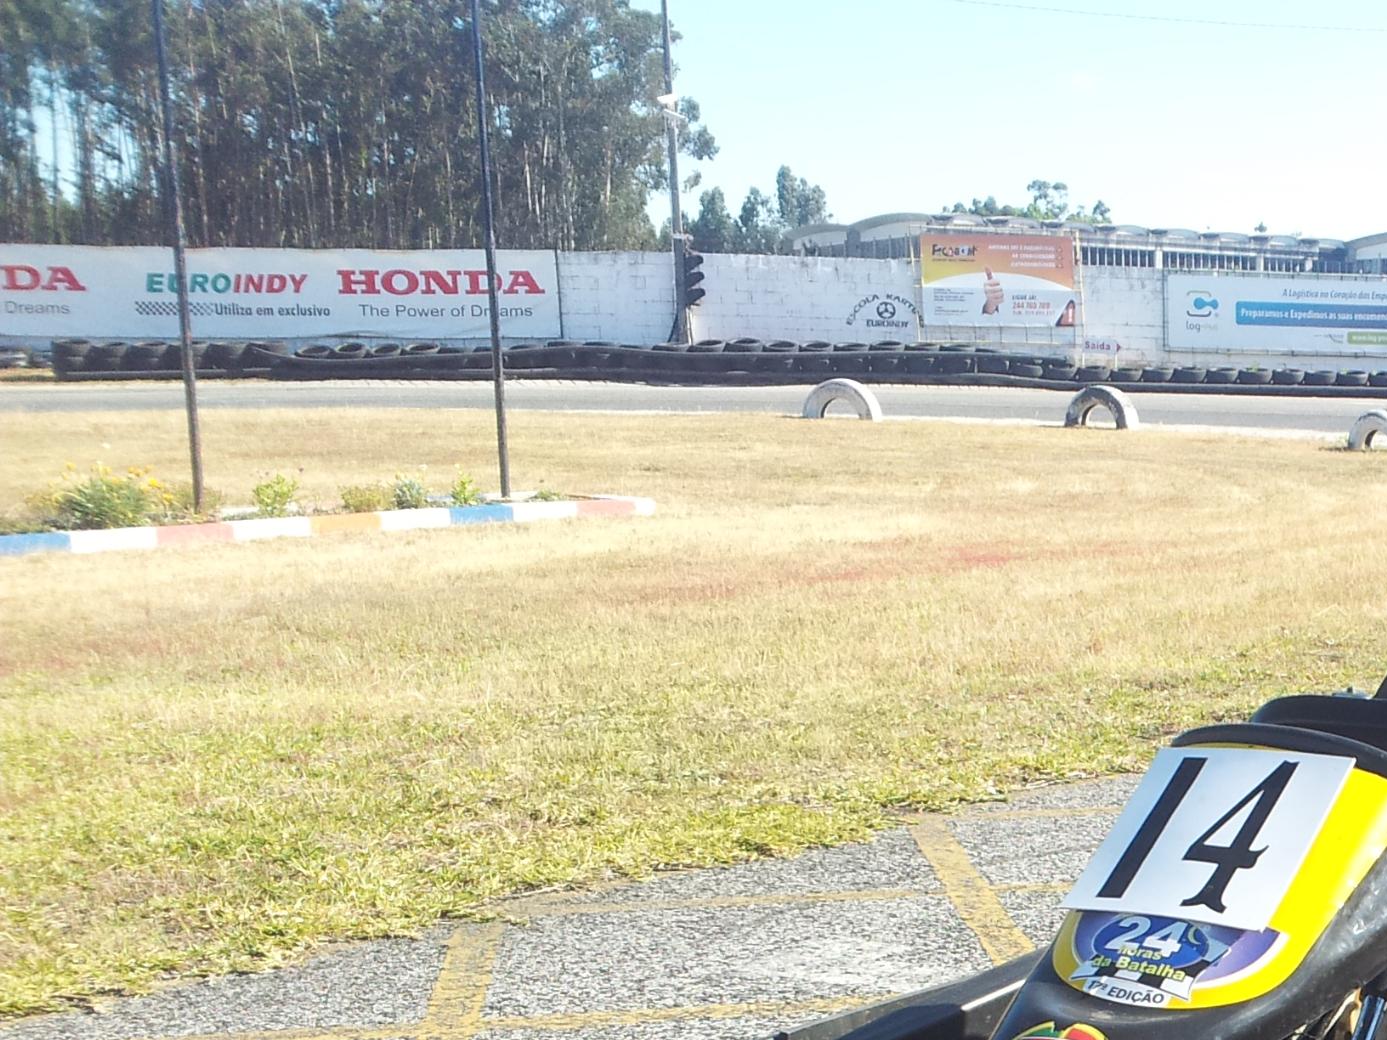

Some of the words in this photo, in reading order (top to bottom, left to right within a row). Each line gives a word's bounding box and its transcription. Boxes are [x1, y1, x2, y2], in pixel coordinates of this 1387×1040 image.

[336, 269, 546, 295] HONDA
[3, 300, 71, 314] Dreams
[214, 303, 251, 316] Utiliza
[256, 306, 274, 316] em
[279, 304, 330, 317] exclusivo
[359, 304, 389, 317] The
[395, 305, 445, 317] Power
[450, 304, 465, 317] of
[471, 304, 533, 318] Drams
[846, 294, 879, 326] ESCOLA
[1096, 757, 1300, 914] 14
[1105, 915, 1189, 958] 24
[1091, 955, 1111, 967] da
[1115, 956, 1186, 982] Batalha
[1107, 986, 1165, 1005] EDIÇÃO
